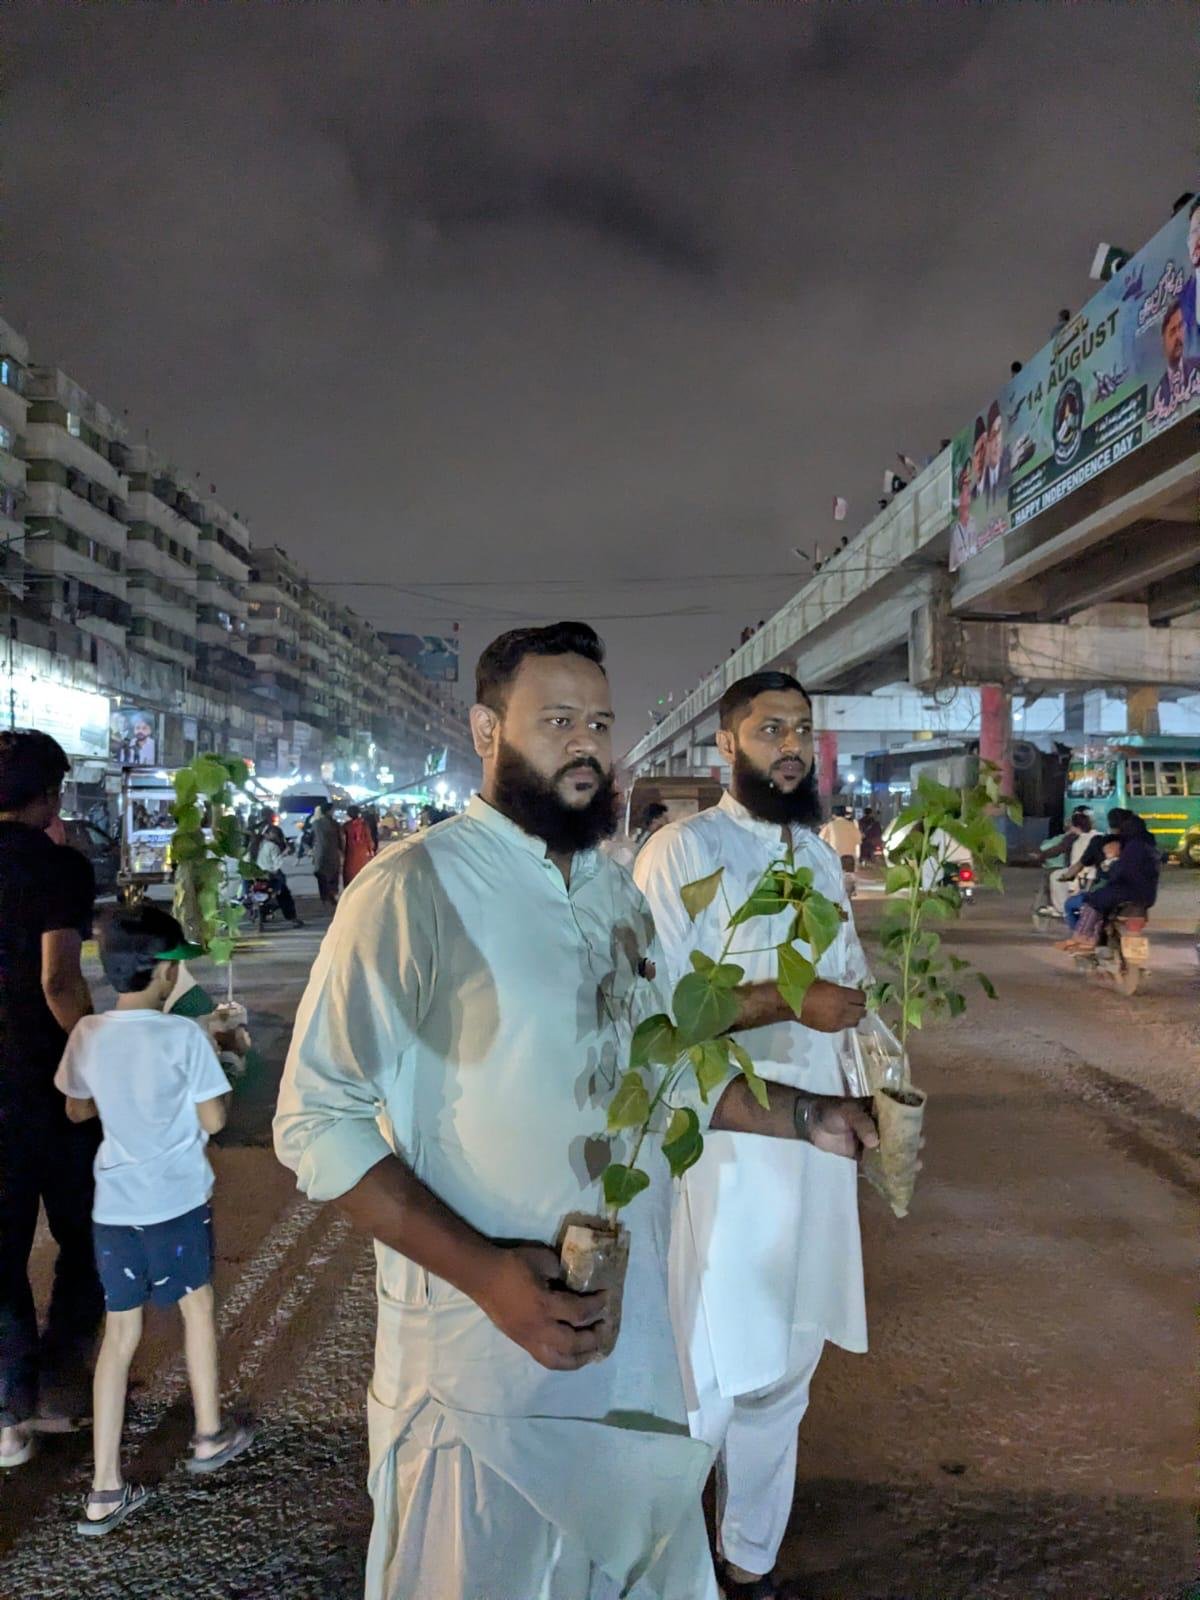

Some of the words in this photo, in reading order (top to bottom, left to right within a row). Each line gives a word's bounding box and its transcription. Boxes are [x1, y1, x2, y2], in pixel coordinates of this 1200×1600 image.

[1026, 381, 1043, 410] 14
[1047, 307, 1120, 395] AUGUST
[1014, 498, 1041, 526] HAPPY
[1042, 450, 1111, 507] INDEPENDENCE
[1112, 433, 1135, 460] DAY
